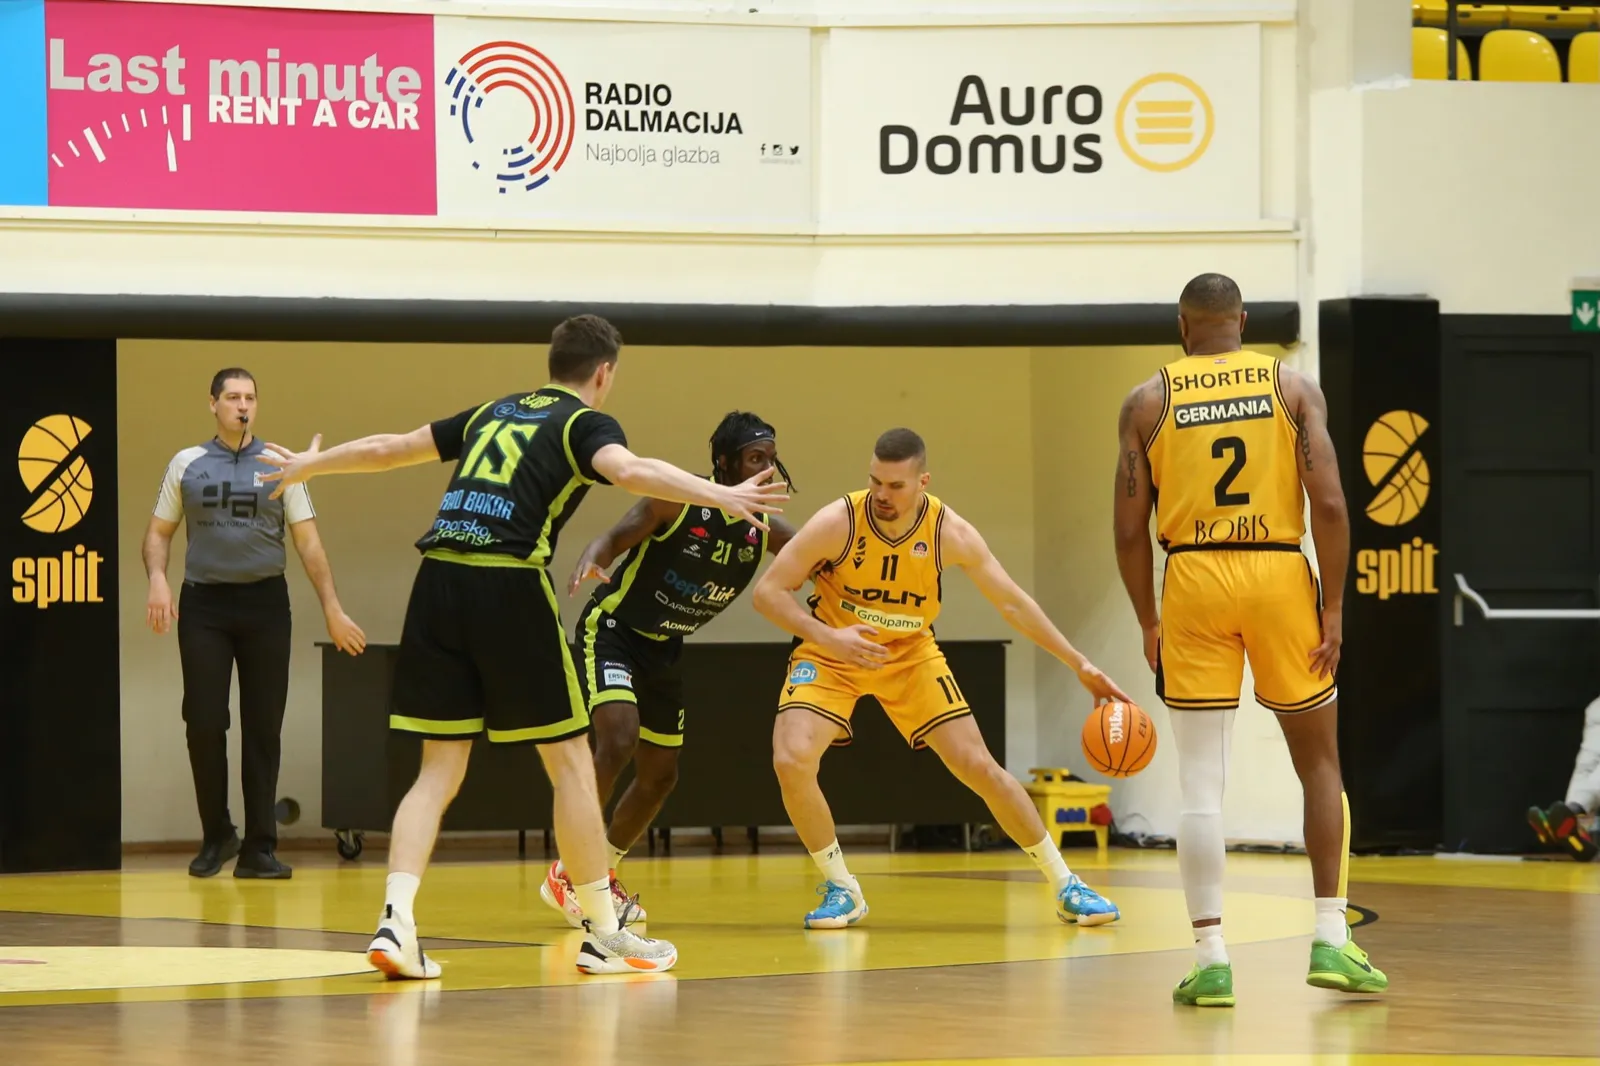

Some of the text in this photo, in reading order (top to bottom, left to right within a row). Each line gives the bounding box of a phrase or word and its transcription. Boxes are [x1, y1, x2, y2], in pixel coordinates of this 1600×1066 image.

[49, 38, 422, 103] Last minute
[585, 82, 672, 106] RADIO
[950, 75, 1103, 126] Auro
[208, 94, 420, 130] RENT A CAR
[585, 109, 743, 134] DALMACIJA
[585, 143, 720, 166] Najbolja glazba
[880, 125, 1103, 175] Domus
[1172, 367, 1271, 392] SHORTER
[1175, 399, 1272, 425] GERMANIA
[459, 419, 541, 485] 15
[1211, 436, 1250, 507] 2
[463, 491, 515, 521] BAKAR
[1194, 513, 1270, 544] BOBIS
[711, 540, 732, 566] 21
[881, 555, 899, 581] 11
[1356, 537, 1439, 600] split
[12, 544, 104, 609] split
[858, 609, 921, 629] Groupama
[936, 674, 962, 705] 11
